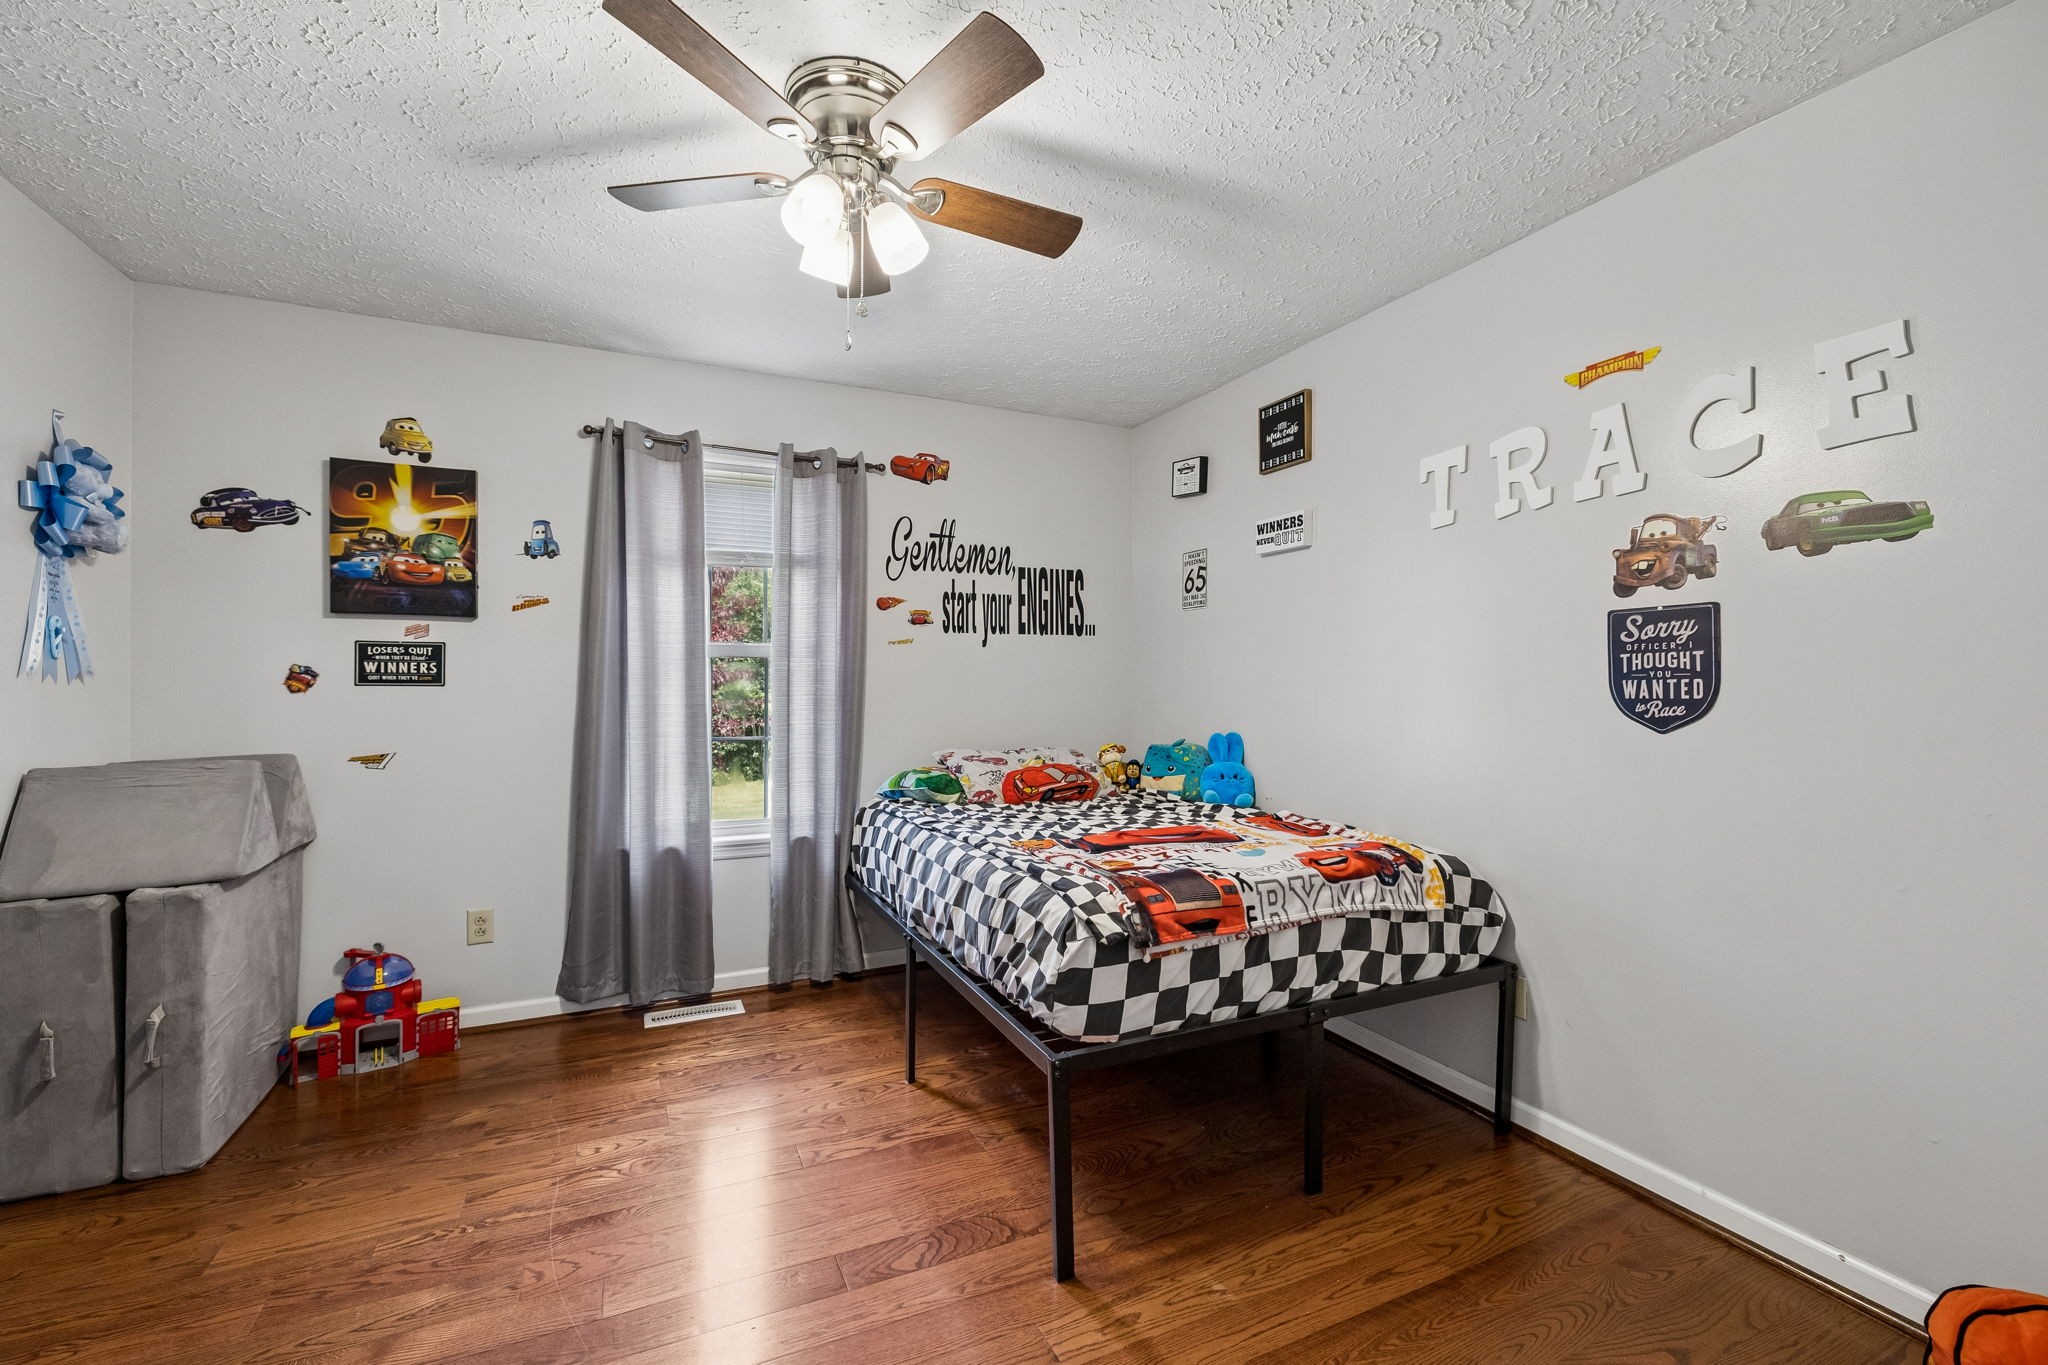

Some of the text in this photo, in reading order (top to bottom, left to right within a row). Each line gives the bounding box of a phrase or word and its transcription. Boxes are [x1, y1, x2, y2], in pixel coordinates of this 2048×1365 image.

[1580, 353, 1643, 386] CHAMPION
[1420, 319, 1917, 529] TRACE
[1256, 514, 1304, 536] WINNERS
[1256, 527, 1304, 547] NEVER QUIT
[886, 516, 1016, 581] Gentlemen,
[1184, 557, 1206, 567] SPEEDING
[1184, 565, 1207, 594] 65
[942, 566, 1096, 648] start your ENGINES...
[1620, 614, 1698, 644] Sorry
[367, 646, 433, 656] LOSERS QUIT
[1689, 641, 1693, 649] I
[363, 661, 437, 674] WINNERS
[1620, 650, 1704, 674] THOUGHT
[1649, 670, 1671, 678] YOU
[1622, 678, 1704, 700] WANTED
[1635, 700, 1687, 719] to Race
[1256, 869, 1428, 926] RYMAN
